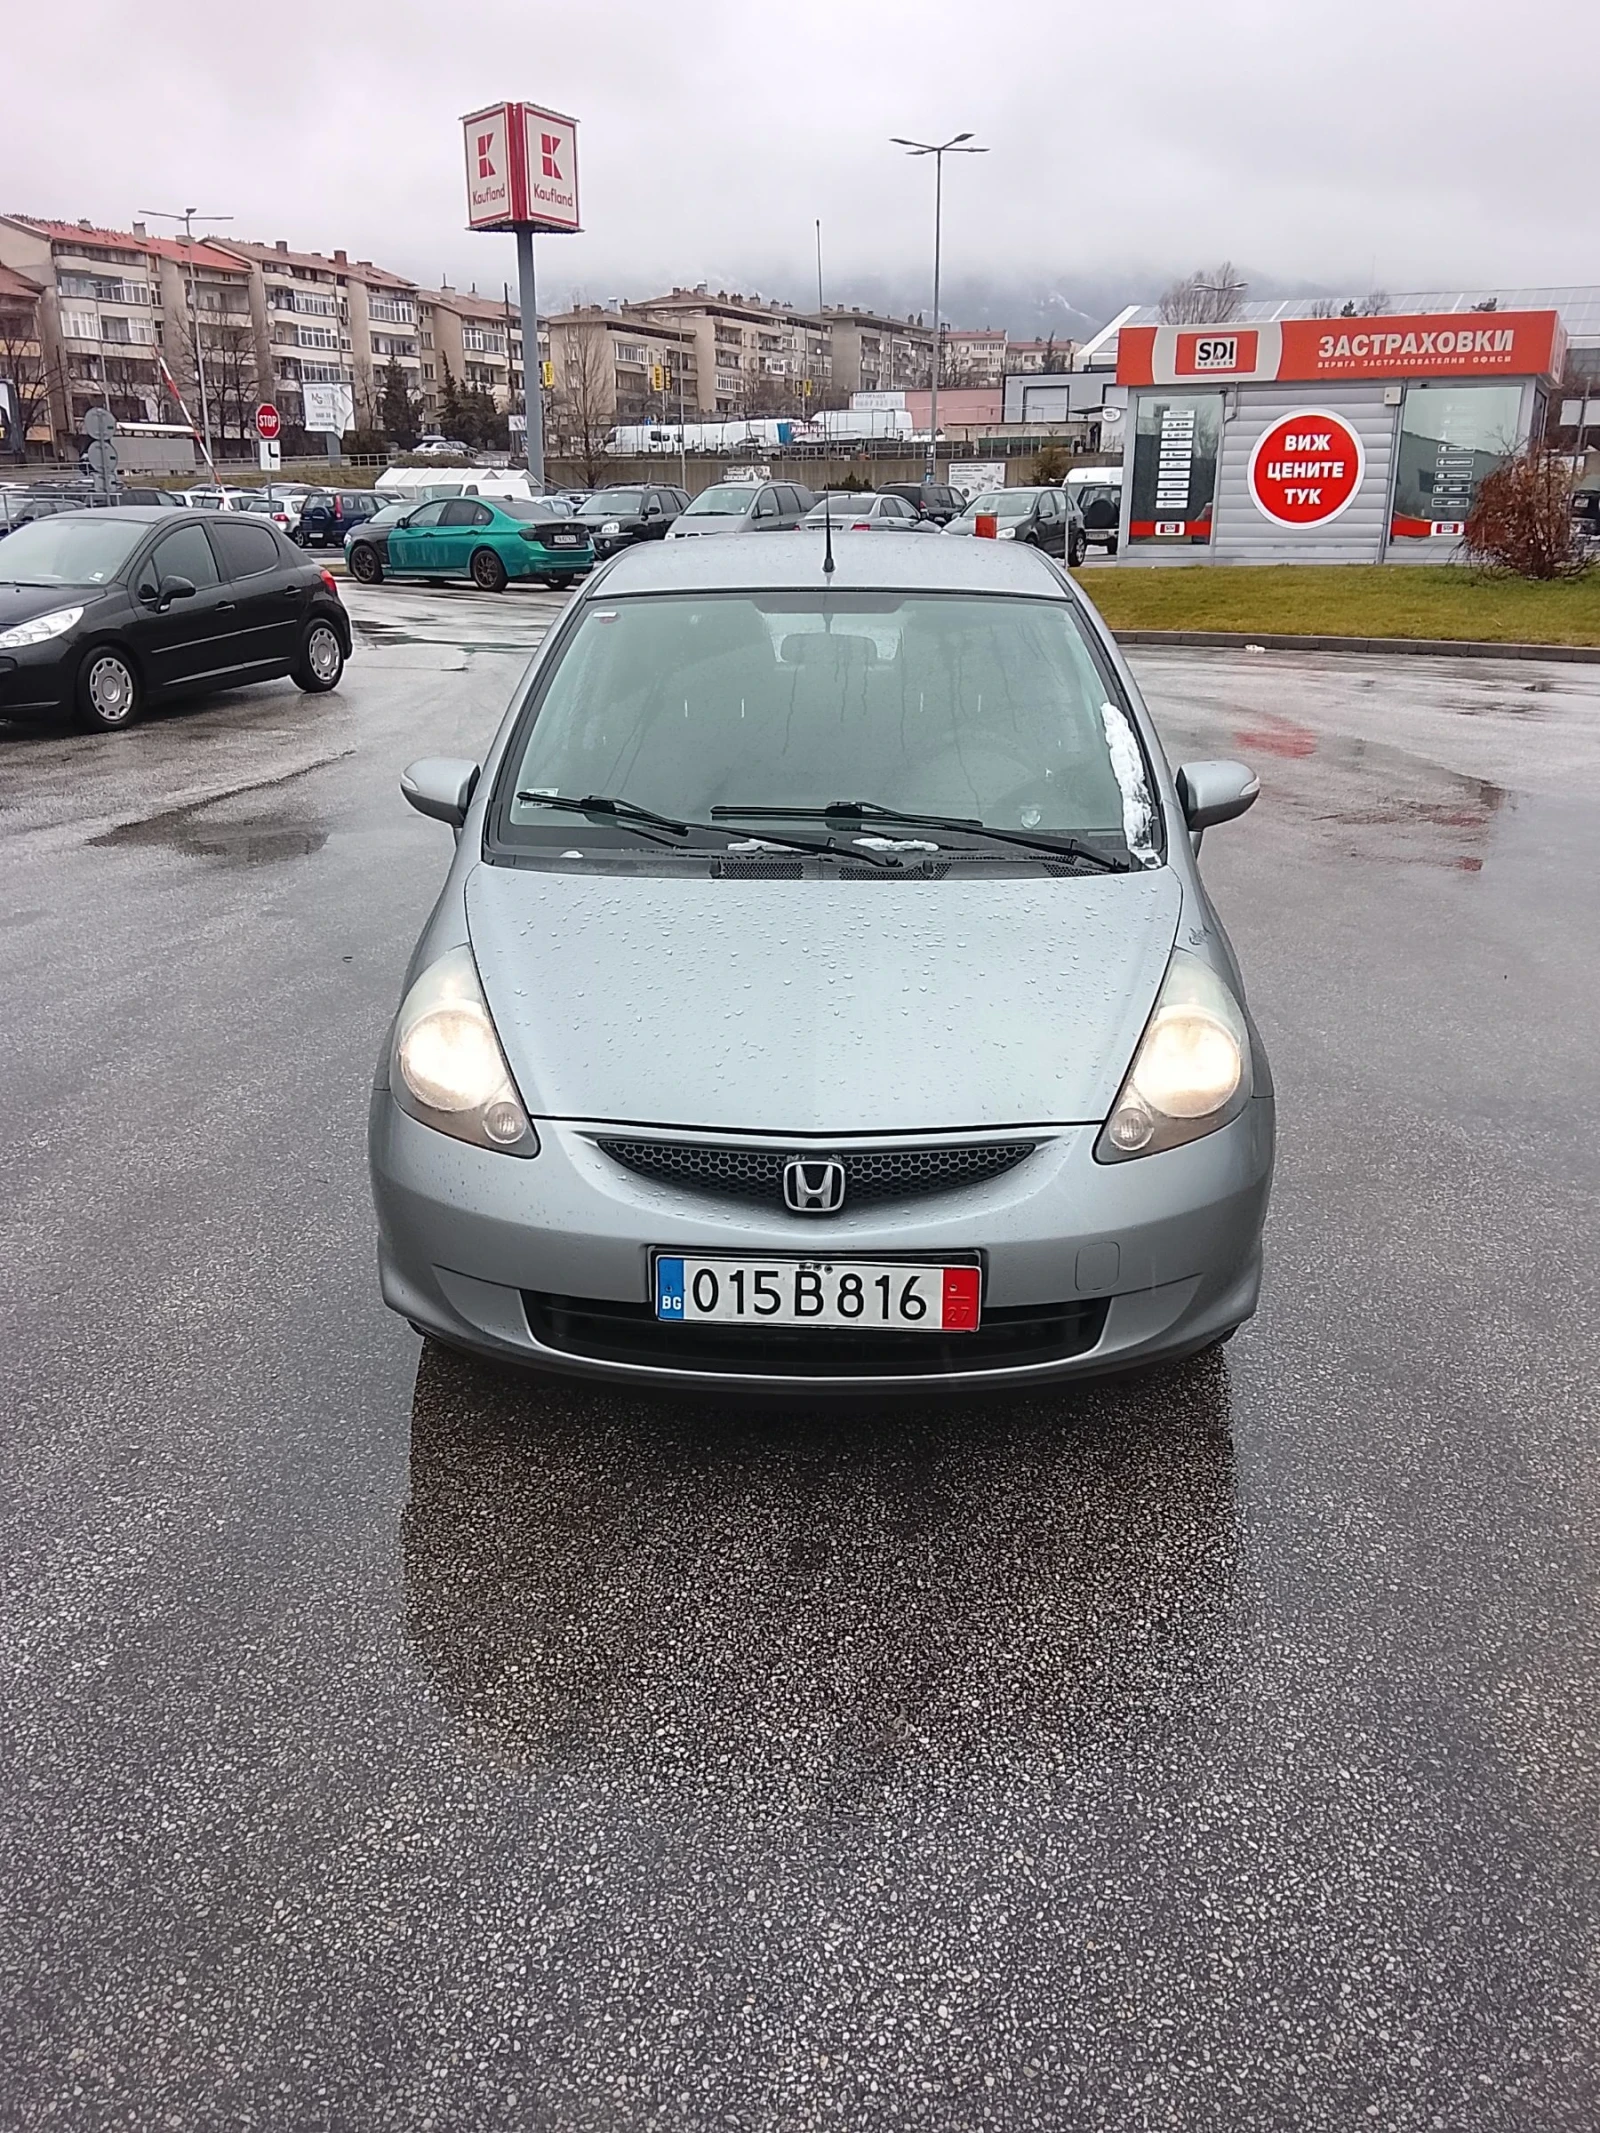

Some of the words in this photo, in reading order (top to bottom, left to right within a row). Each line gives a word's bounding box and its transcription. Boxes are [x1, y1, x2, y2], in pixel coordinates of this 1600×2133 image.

[472, 183, 506, 206] Kaufland
[533, 183, 573, 207] Kaufland
[1198, 341, 1235, 361] SDI
[1318, 330, 1514, 358] ЗАСТРАХОВКИ
[1317, 360, 1356, 368] ВЕРИГА
[1362, 357, 1466, 368] ЗАСТРАХОВАТЕЛНИ
[1472, 355, 1512, 364] ОФИСИ
[259, 415, 277, 428] STOP
[1284, 434, 1332, 451] ВИЖ
[1267, 461, 1345, 481] ЦЕНИТЕ
[1284, 488, 1323, 505] ТУК
[661, 1295, 682, 1310] BG
[692, 1268, 927, 1320] 015B816
